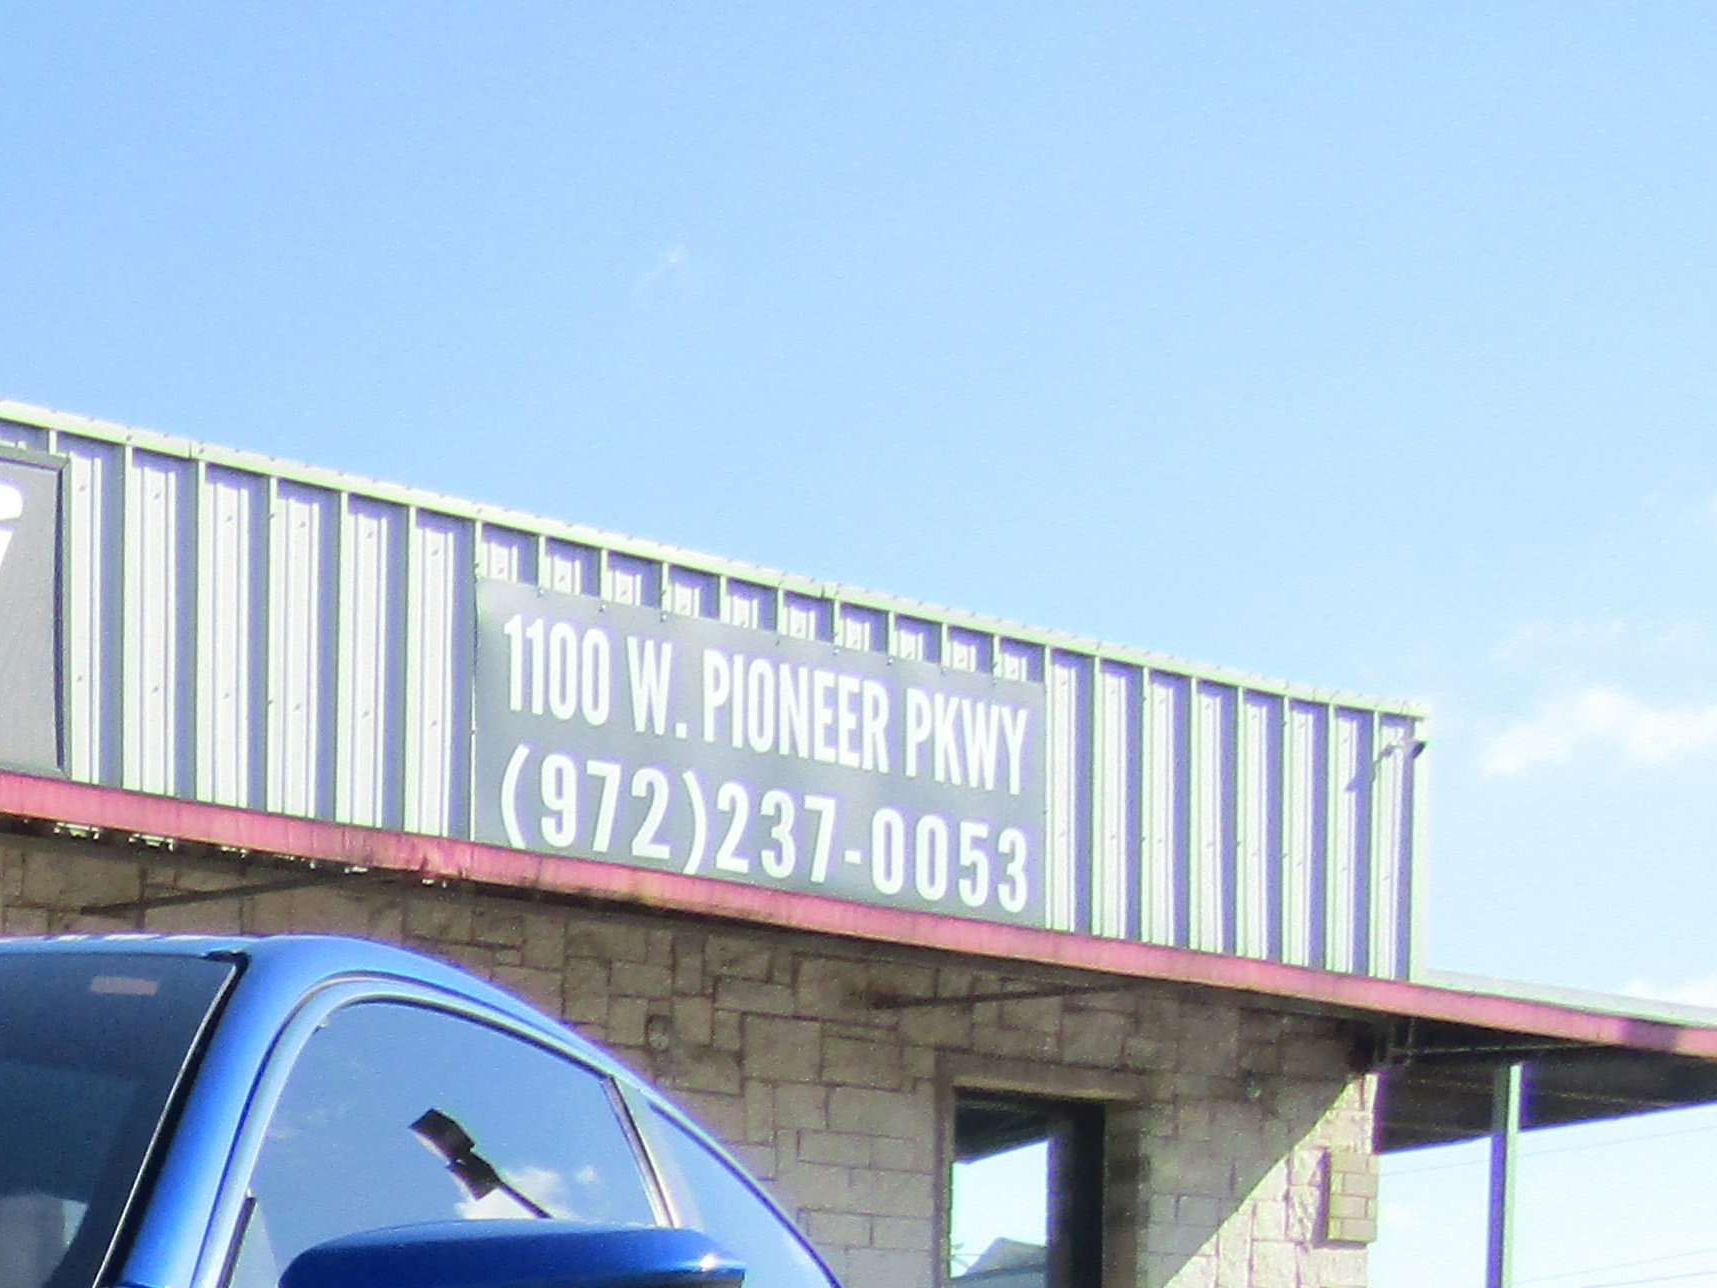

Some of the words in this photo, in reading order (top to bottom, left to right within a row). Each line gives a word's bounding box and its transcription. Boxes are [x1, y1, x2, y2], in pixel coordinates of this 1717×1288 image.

[502, 612, 612, 727] 1100
[626, 634, 689, 740] W.
[702, 647, 891, 774] PIONEER
[905, 686, 1029, 796] PKWY
[500, 742, 1030, 914] (972)237-0053
